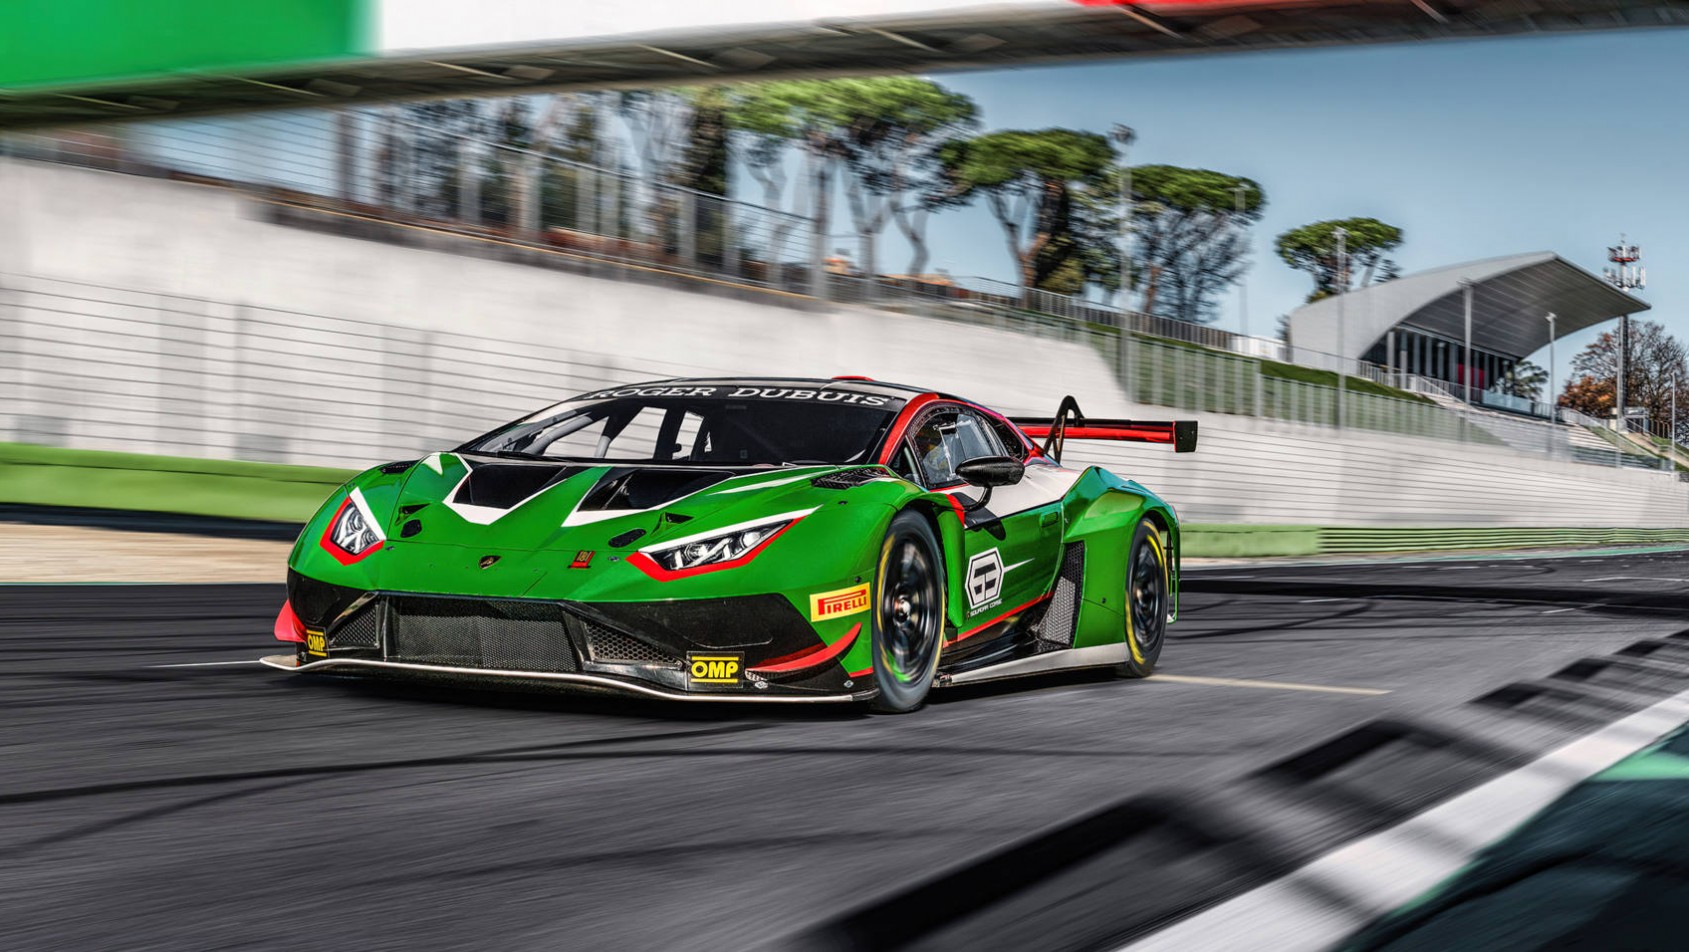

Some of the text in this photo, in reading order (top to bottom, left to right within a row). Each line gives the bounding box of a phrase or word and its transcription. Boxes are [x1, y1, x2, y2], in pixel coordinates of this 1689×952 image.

[586, 386, 889, 406] ROGER DUBUIS
[817, 588, 867, 616] PIRELLI
[307, 634, 326, 651] OMP
[691, 661, 739, 679] OMP
